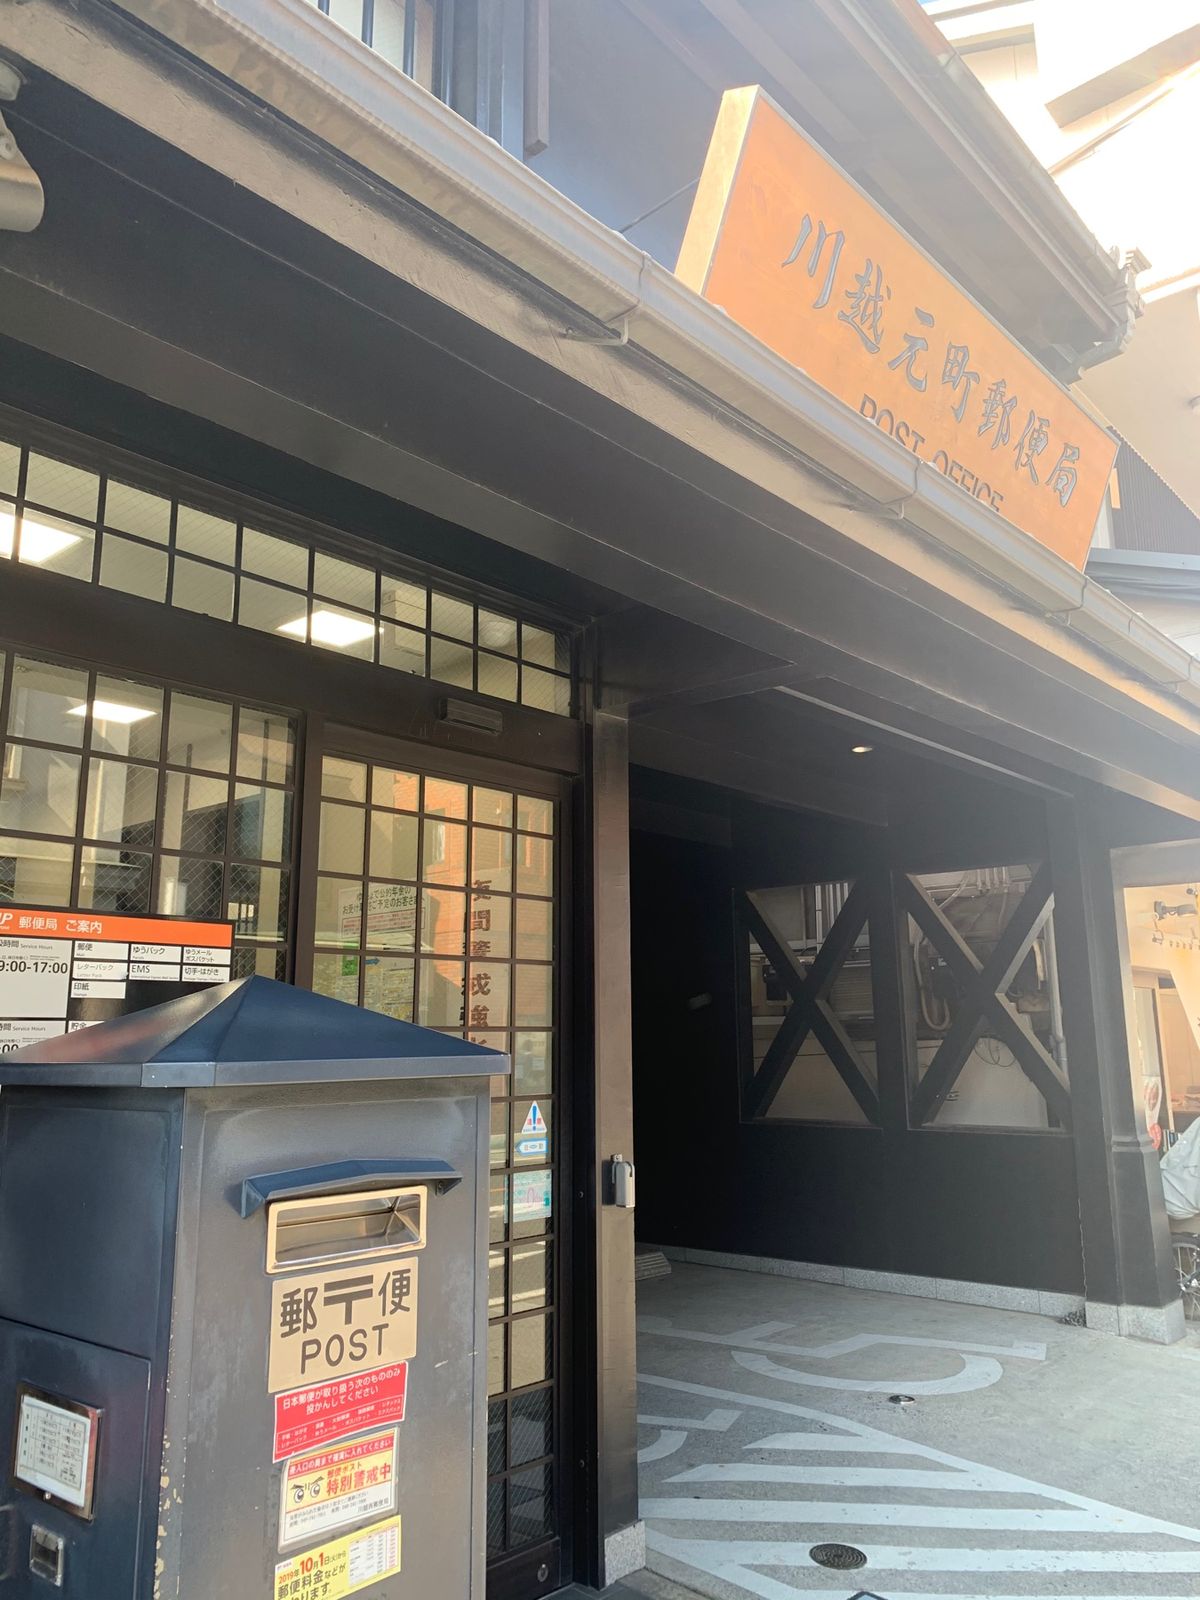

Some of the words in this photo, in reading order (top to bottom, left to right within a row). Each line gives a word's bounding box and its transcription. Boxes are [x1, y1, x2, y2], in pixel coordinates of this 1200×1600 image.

[781, 213, 1081, 508] 川越元町郵便局
[859, 393, 926, 453] POST
[19, 916, 58, 931] 郵便局
[65, 919, 103, 934] ご案内
[77, 943, 93, 952] 郵便
[133, 946, 166, 955] ゆうパック
[131, 964, 150, 973] EMS
[74, 982, 90, 991] 印紙
[300, 1323, 389, 1374] POST
[282, 1367, 401, 1410] 日本郵便が取り扱う次のもののみ
[306, 1385, 379, 1415] 投かんしてください
[327, 1462, 391, 1496] 特別警戒中
[278, 1563, 346, 1599] 郵便料金などが
